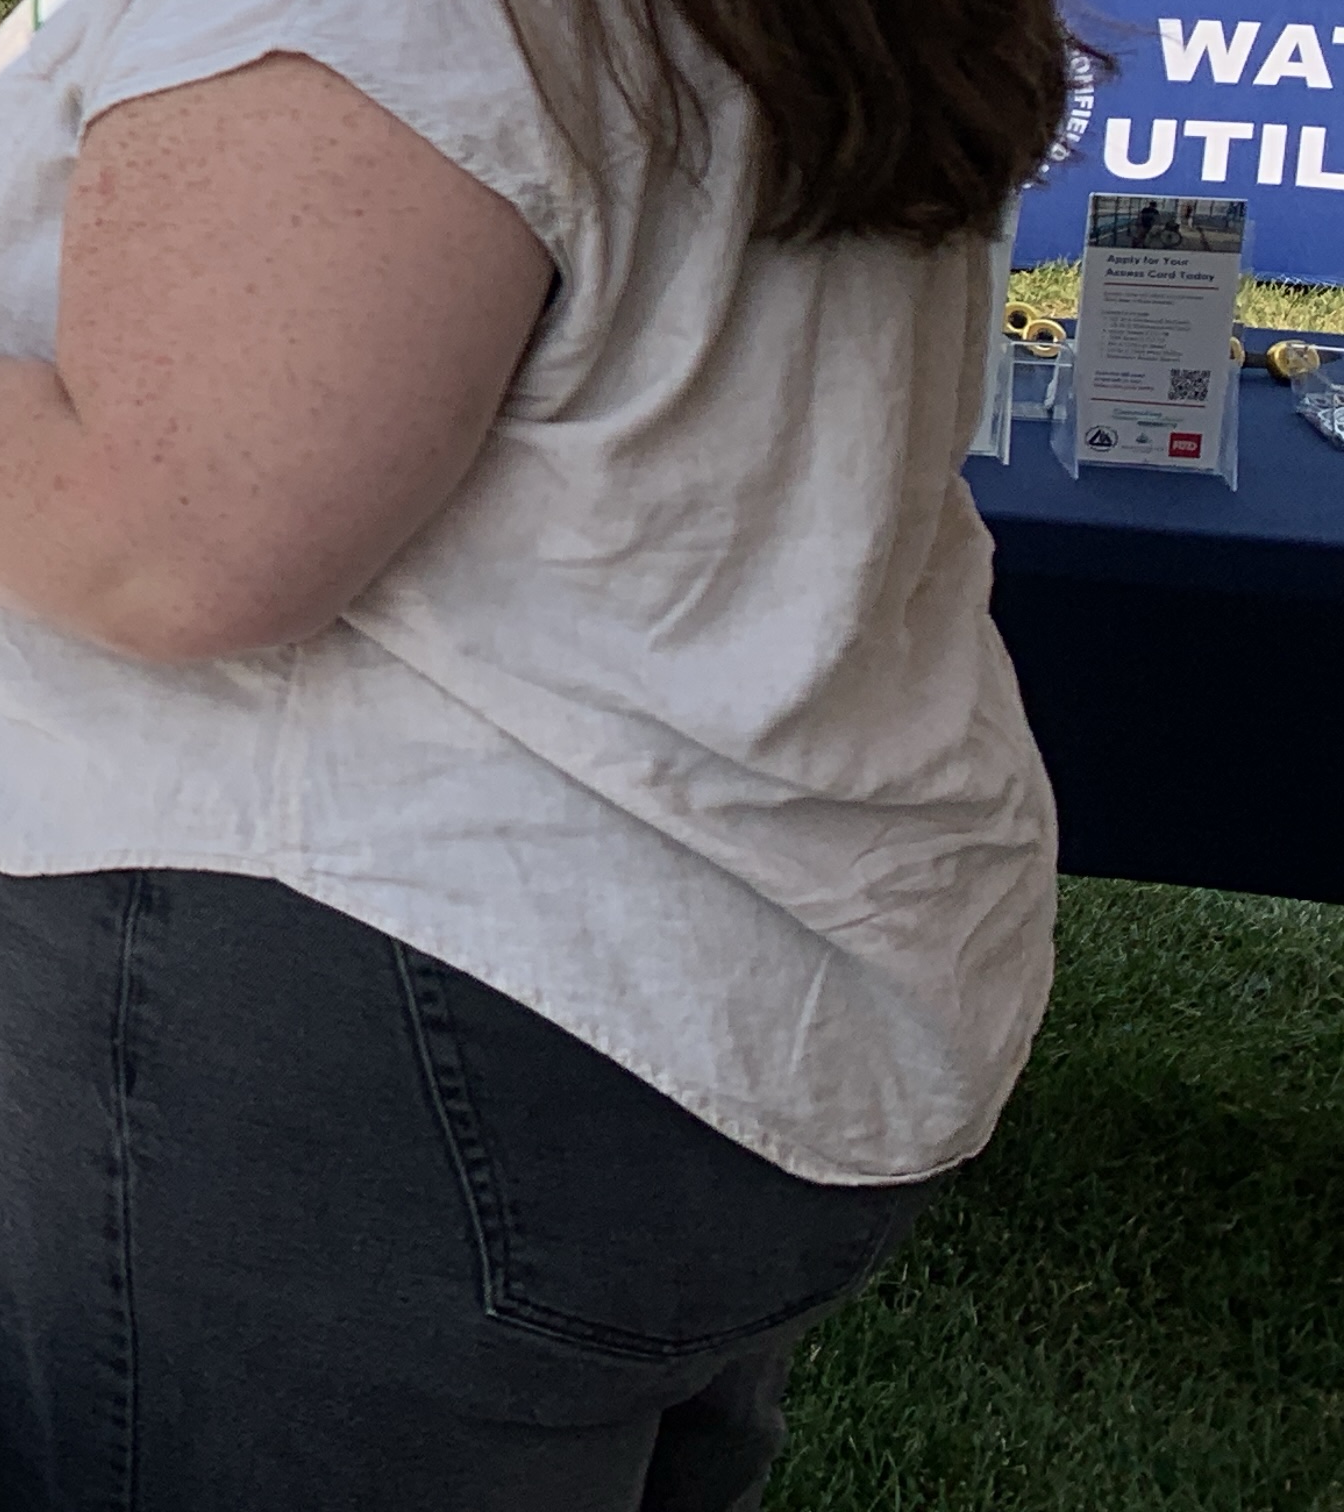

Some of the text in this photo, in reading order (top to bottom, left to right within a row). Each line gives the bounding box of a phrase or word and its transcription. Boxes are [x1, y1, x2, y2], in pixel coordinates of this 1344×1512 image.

[1106, 254, 1190, 266] Apply for Your
[1147, 270, 1176, 280] Card
[1180, 271, 1215, 282] Today
